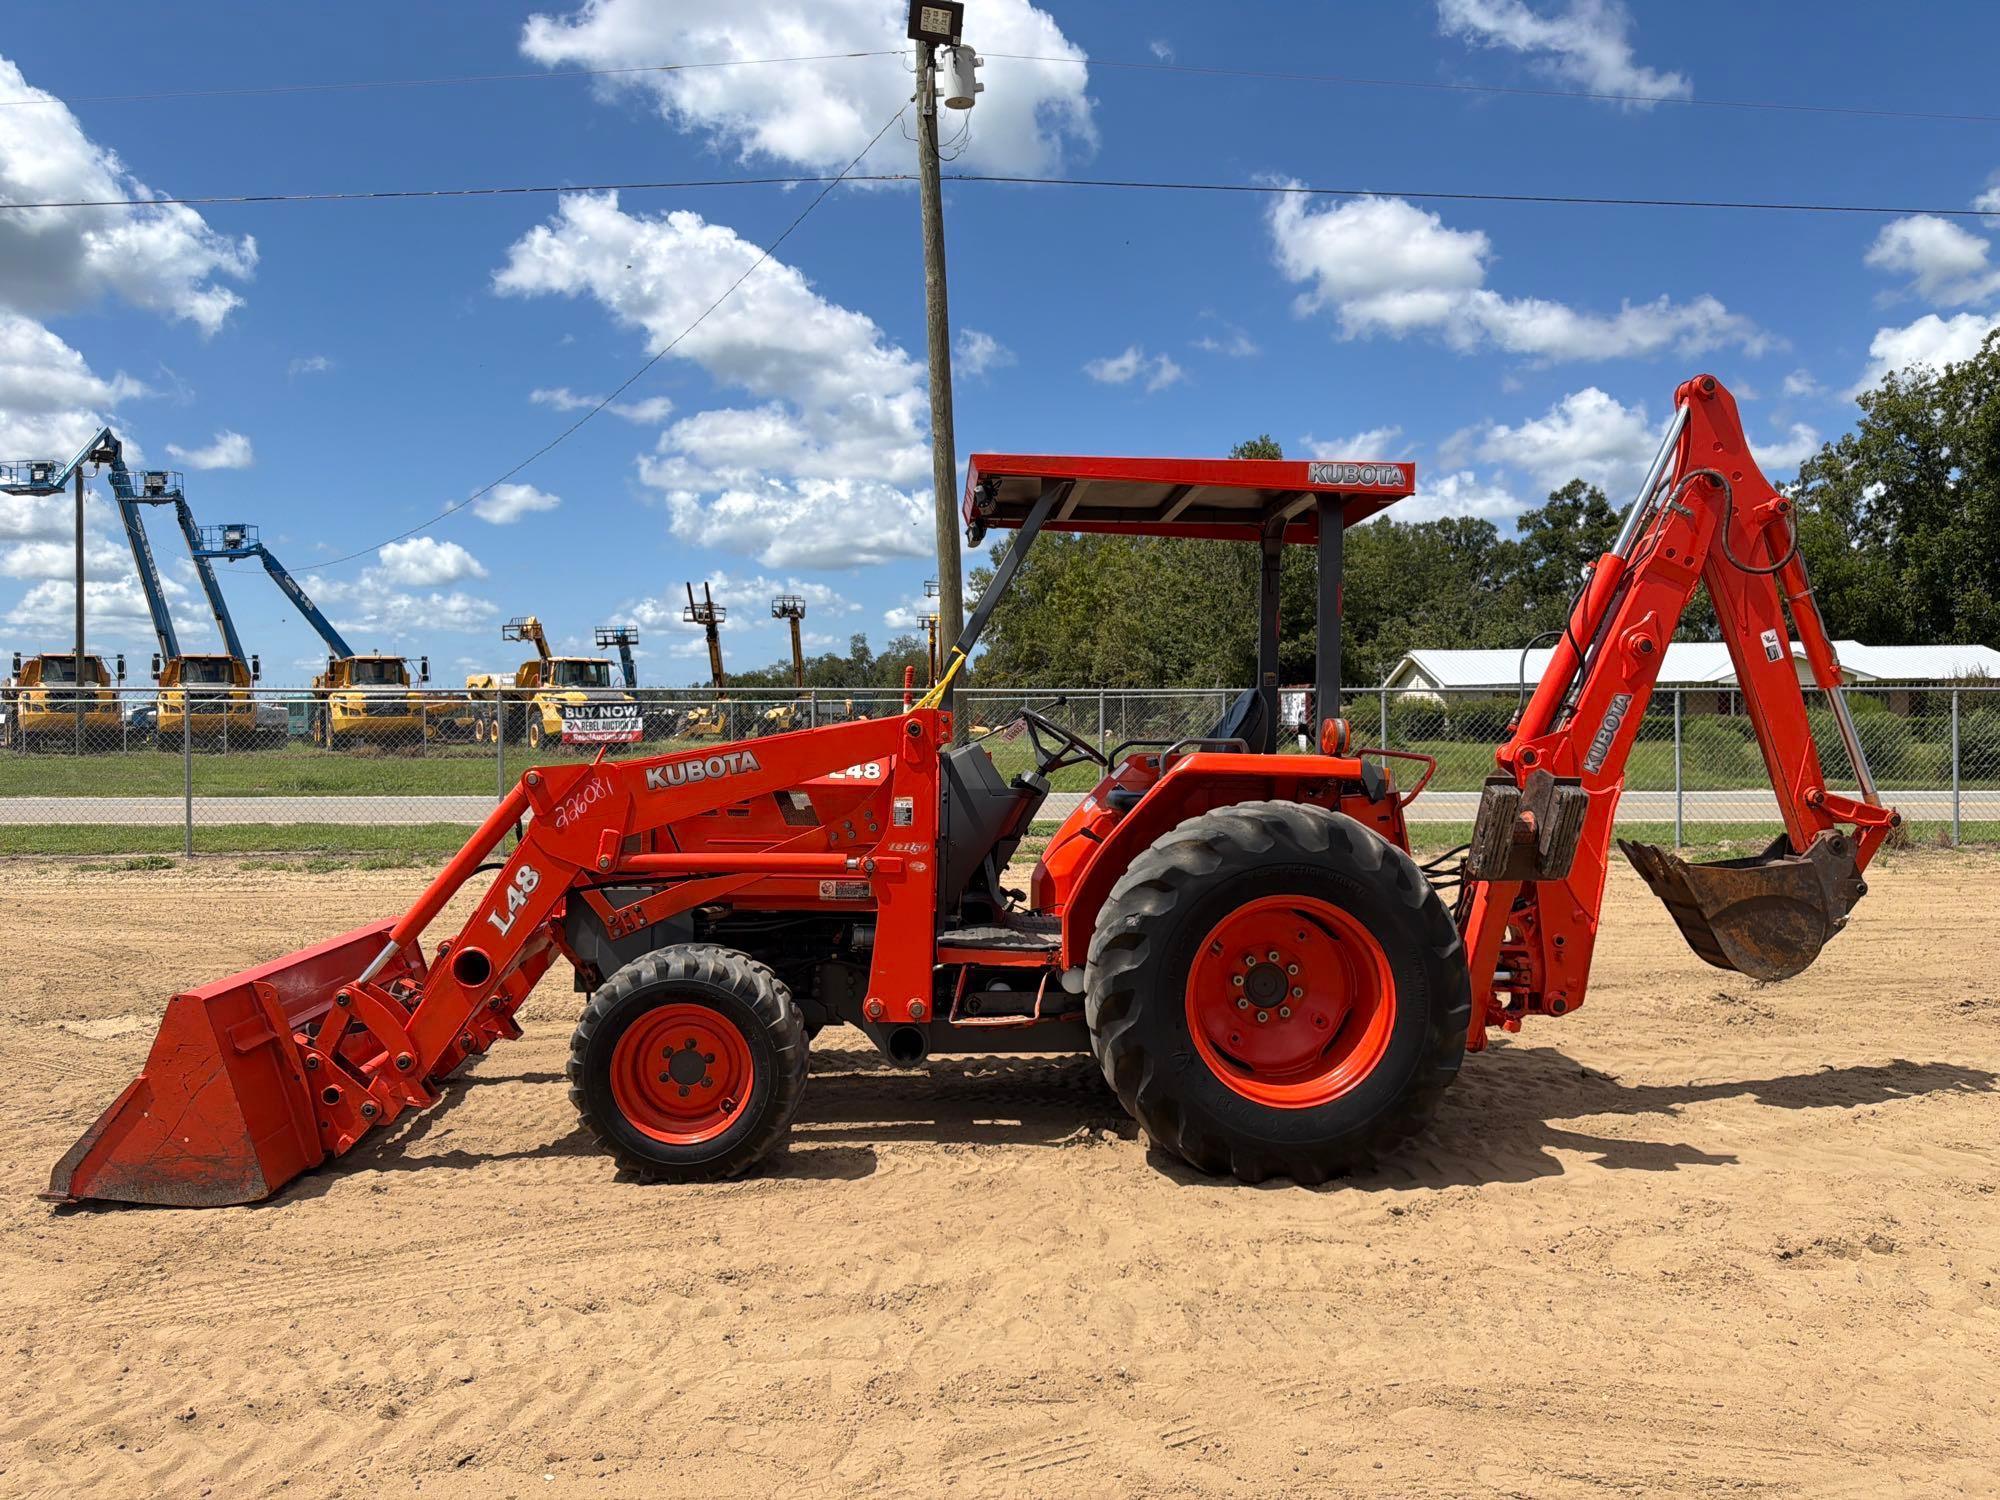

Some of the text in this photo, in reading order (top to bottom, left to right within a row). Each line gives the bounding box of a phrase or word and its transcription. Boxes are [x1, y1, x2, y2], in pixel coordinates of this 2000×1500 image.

[1309, 463, 1406, 486] KUBOTA
[135, 513, 145, 542] Genie
[154, 582, 164, 599] XC
[284, 574, 299, 595] Genie
[565, 705, 638, 719] BUY NOW
[581, 721, 600, 731] REBEL
[602, 720, 629, 731] AUCTION
[1583, 693, 1633, 775] KUBOTA
[645, 749, 761, 790] KUBOTA
[554, 775, 614, 828] 226081
[487, 864, 540, 938] L48
